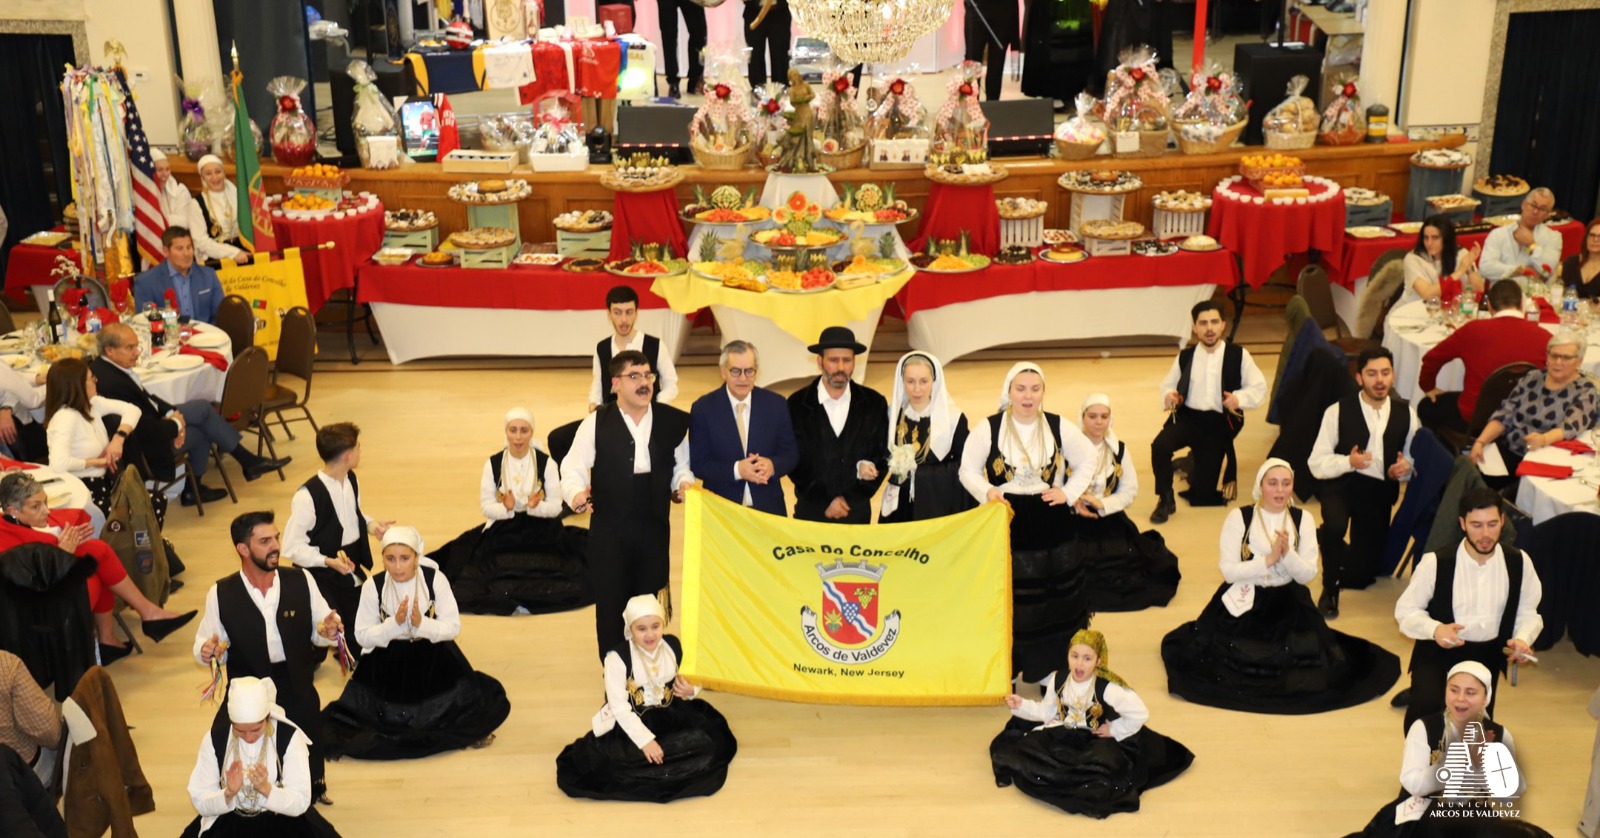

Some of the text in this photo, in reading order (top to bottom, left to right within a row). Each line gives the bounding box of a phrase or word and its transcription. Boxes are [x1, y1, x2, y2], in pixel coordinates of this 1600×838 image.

[772, 544, 930, 565] Casa Do Concelho
[804, 624, 897, 662] Arcos de Valdevez
[793, 663, 905, 678] Newark, New Jersey
